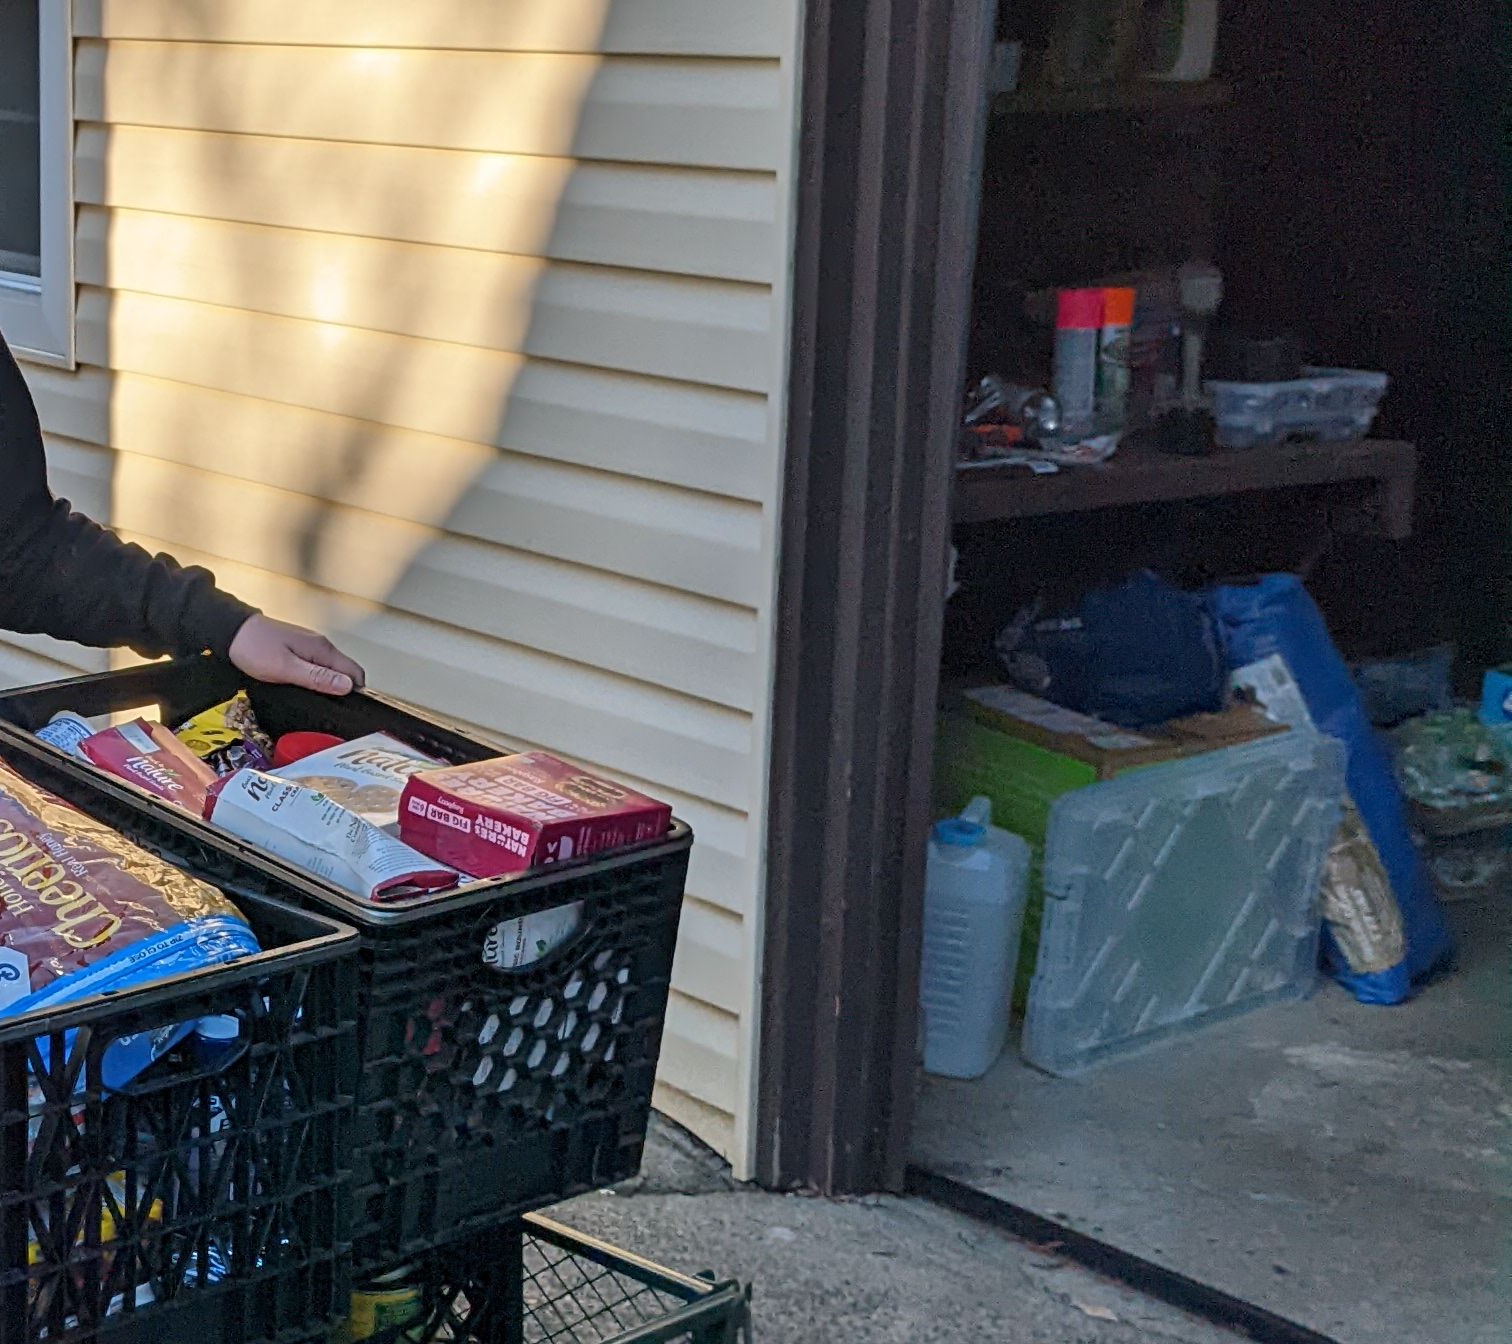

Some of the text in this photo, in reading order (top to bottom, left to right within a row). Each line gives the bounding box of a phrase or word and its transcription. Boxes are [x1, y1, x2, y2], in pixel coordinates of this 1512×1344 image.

[126, 756, 184, 791] nature
[272, 784, 294, 812] CLASS
[430, 806, 468, 830] FIG BAR
[475, 814, 530, 846] BAKERY
[39, 831, 88, 877] Real Honey
[129, 934, 185, 964] ZIP TO CLOSE
